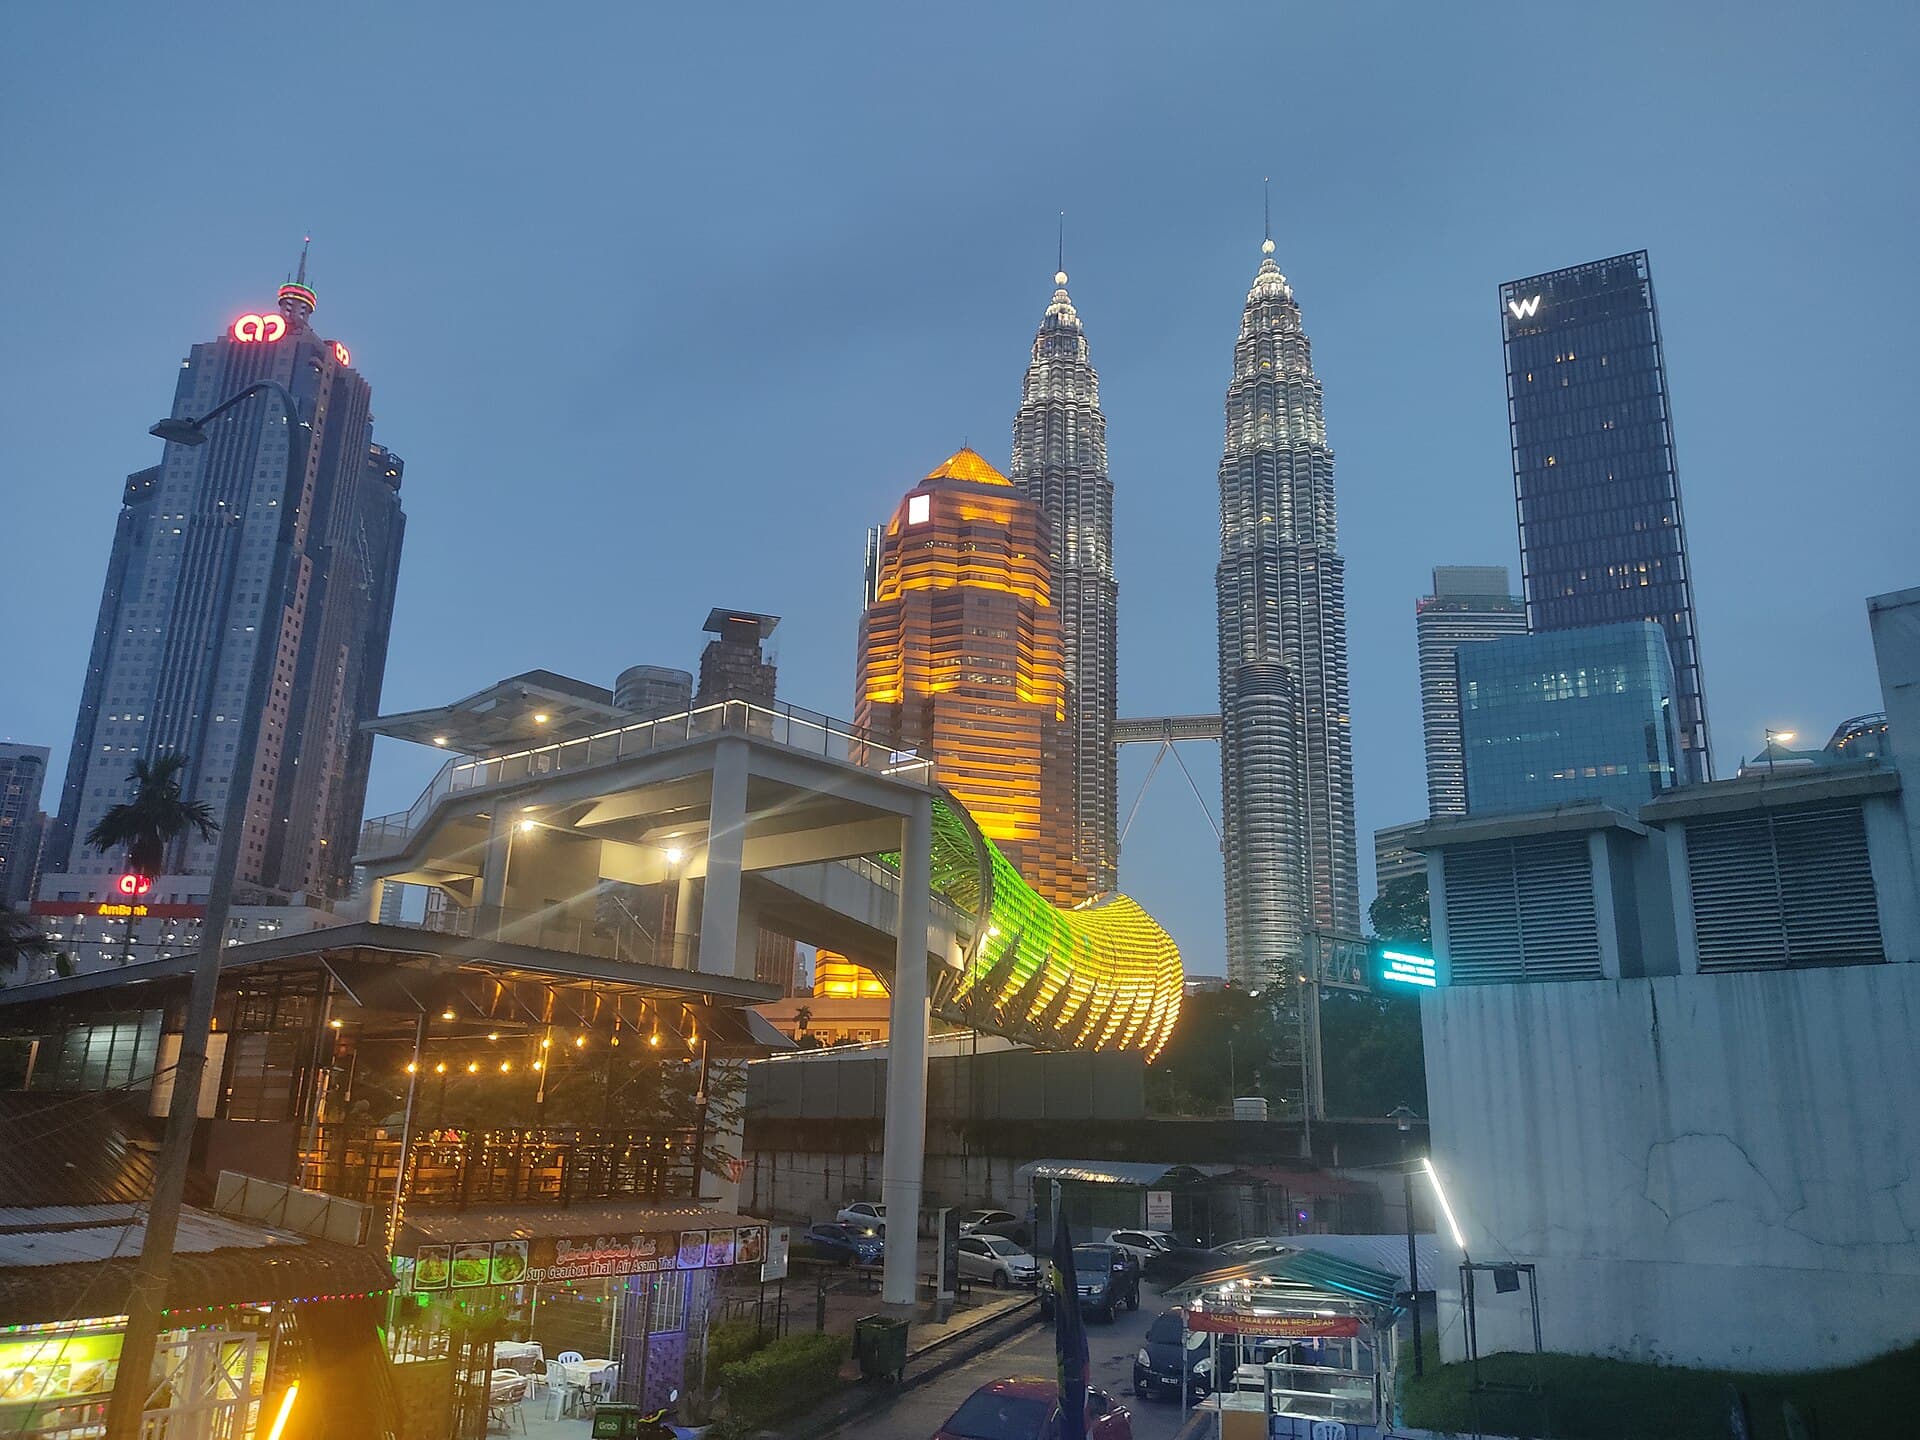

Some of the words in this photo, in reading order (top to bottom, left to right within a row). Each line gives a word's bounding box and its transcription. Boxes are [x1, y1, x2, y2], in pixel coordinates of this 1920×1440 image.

[1508, 295, 1541, 320] W
[99, 904, 148, 916] AmBank
[631, 1235, 657, 1257] Thai
[526, 1268, 546, 1283] Sup
[548, 1261, 587, 1279] Gearbox
[590, 1260, 612, 1275] Thai
[616, 1258, 632, 1274] Air
[631, 1257, 658, 1273] Asam
[658, 1255, 677, 1269] Thai
[1265, 1318, 1289, 1326] AYAM
[598, 1421, 618, 1431] Grab
